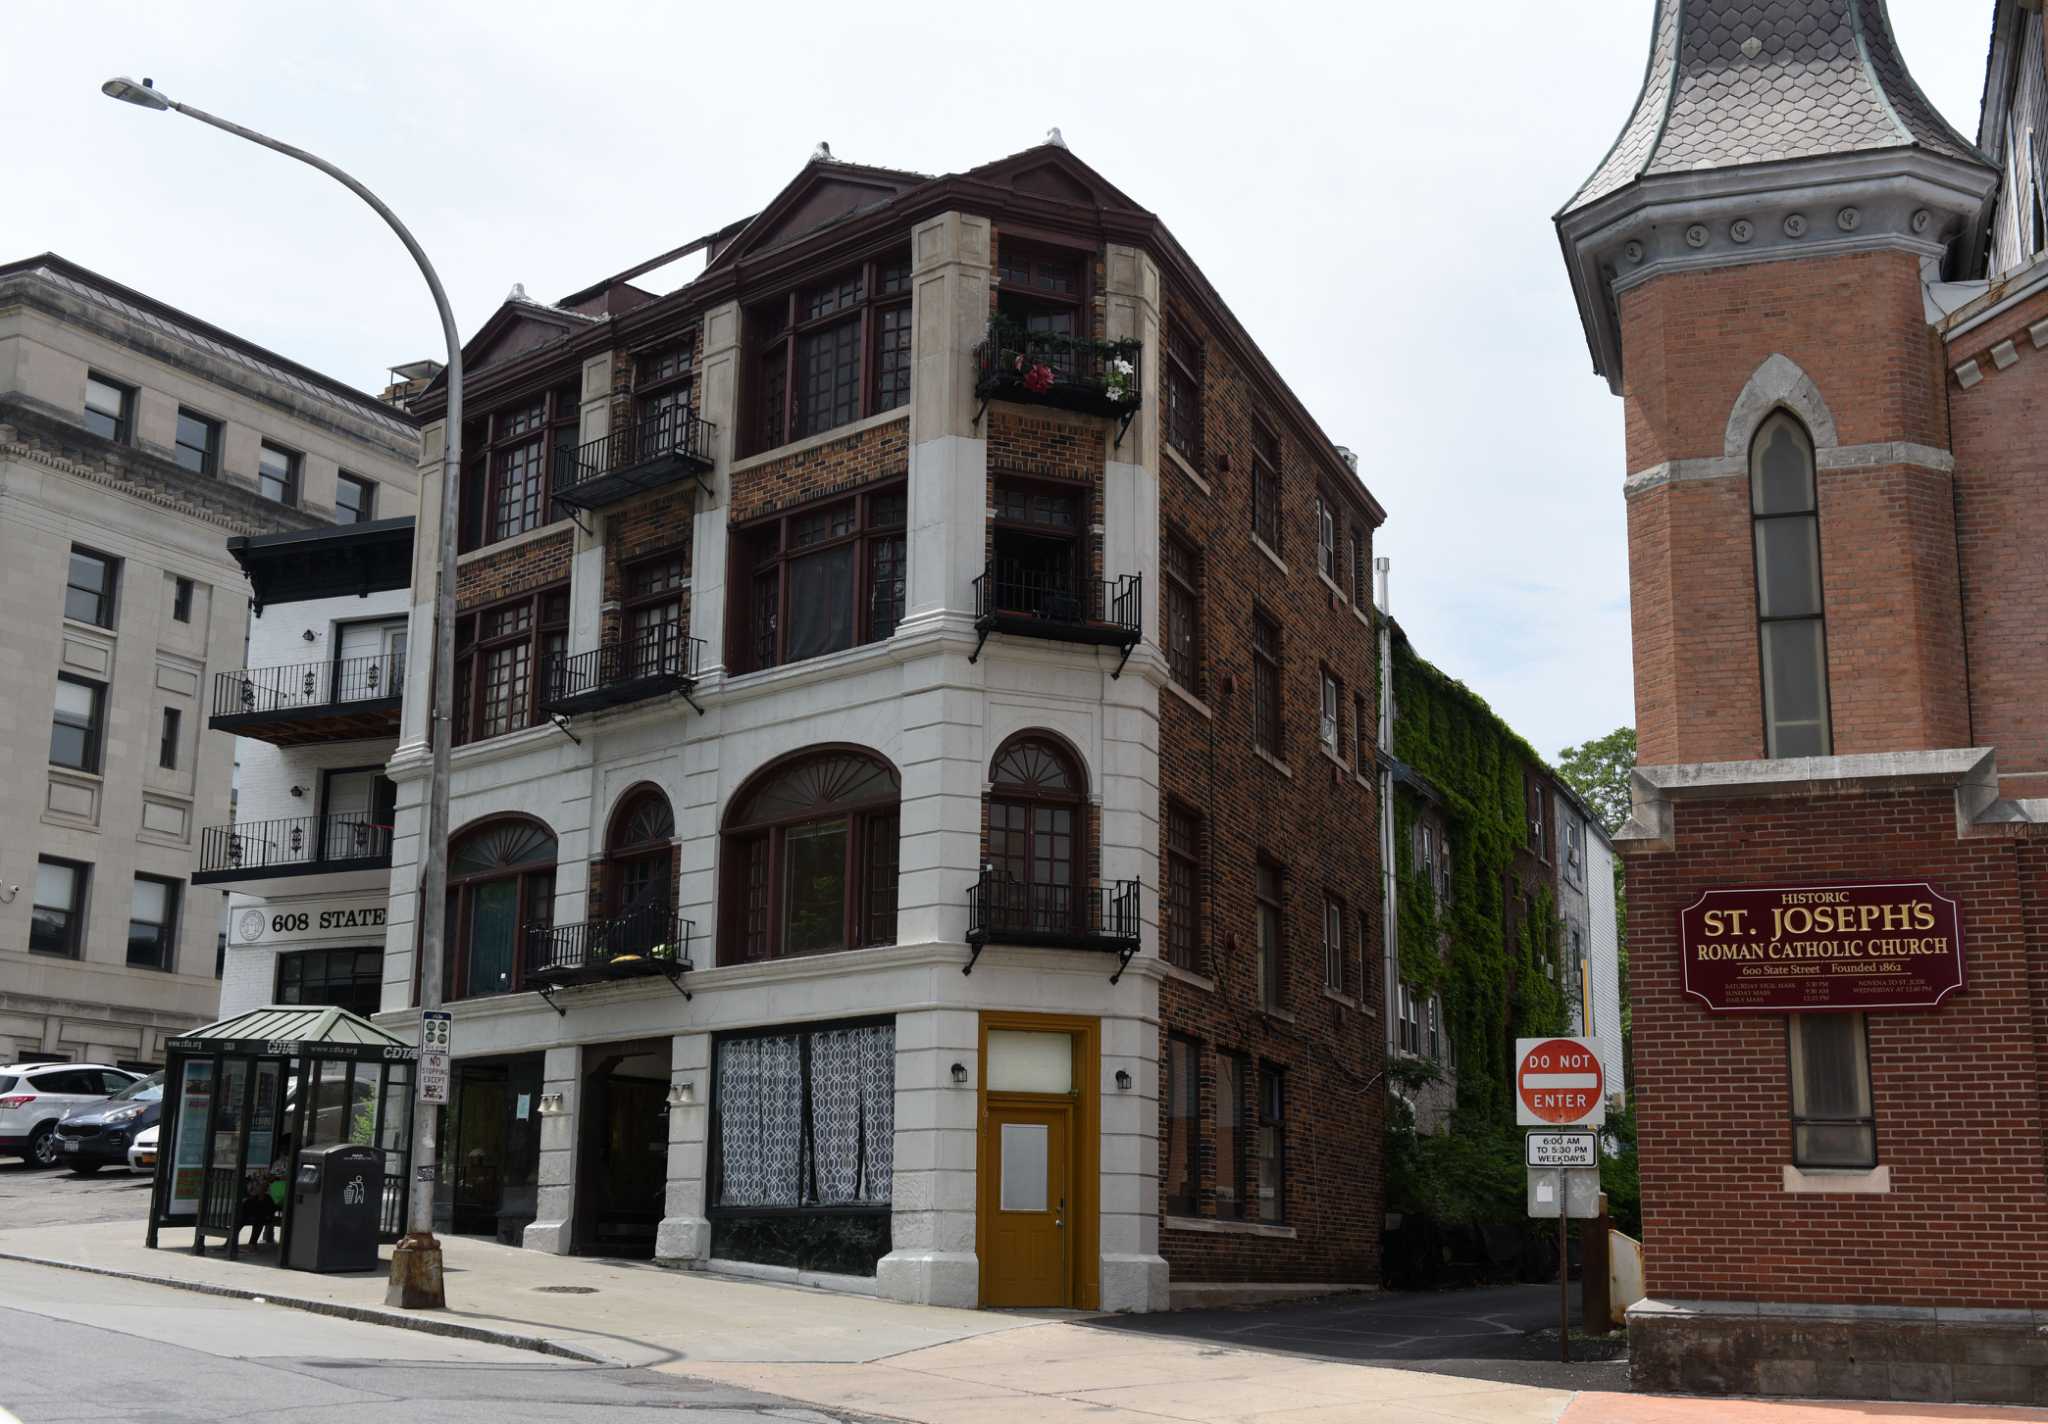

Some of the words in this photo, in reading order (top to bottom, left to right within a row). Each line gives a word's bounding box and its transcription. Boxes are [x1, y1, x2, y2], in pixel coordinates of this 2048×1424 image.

[1782, 891, 1850, 905] HISTORIC
[271, 912, 310, 932] 608
[319, 907, 386, 929] STATE
[1704, 909, 1757, 936] ST.
[1770, 899, 1935, 941] JOSEPH'S
[1697, 943, 1765, 960] ROMAN
[1768, 940, 1863, 959] CATHOLIC
[1868, 937, 1949, 956] CHURCH
[1742, 966, 1762, 975] 600
[1763, 965, 1789, 975] State
[1790, 964, 1820, 975] Street
[1831, 962, 1877, 973] Founded
[1529, 1055, 1550, 1069] DO
[1560, 1054, 1590, 1068] NOT
[1534, 1094, 1586, 1108] ENTER
[1543, 1137, 1563, 1145] 6:00
[1566, 1137, 1580, 1145] AM
[1536, 1146, 1548, 1154] TO
[1574, 1146, 1588, 1154] PM
[1538, 1155, 1586, 1163] WEEKDAYS
